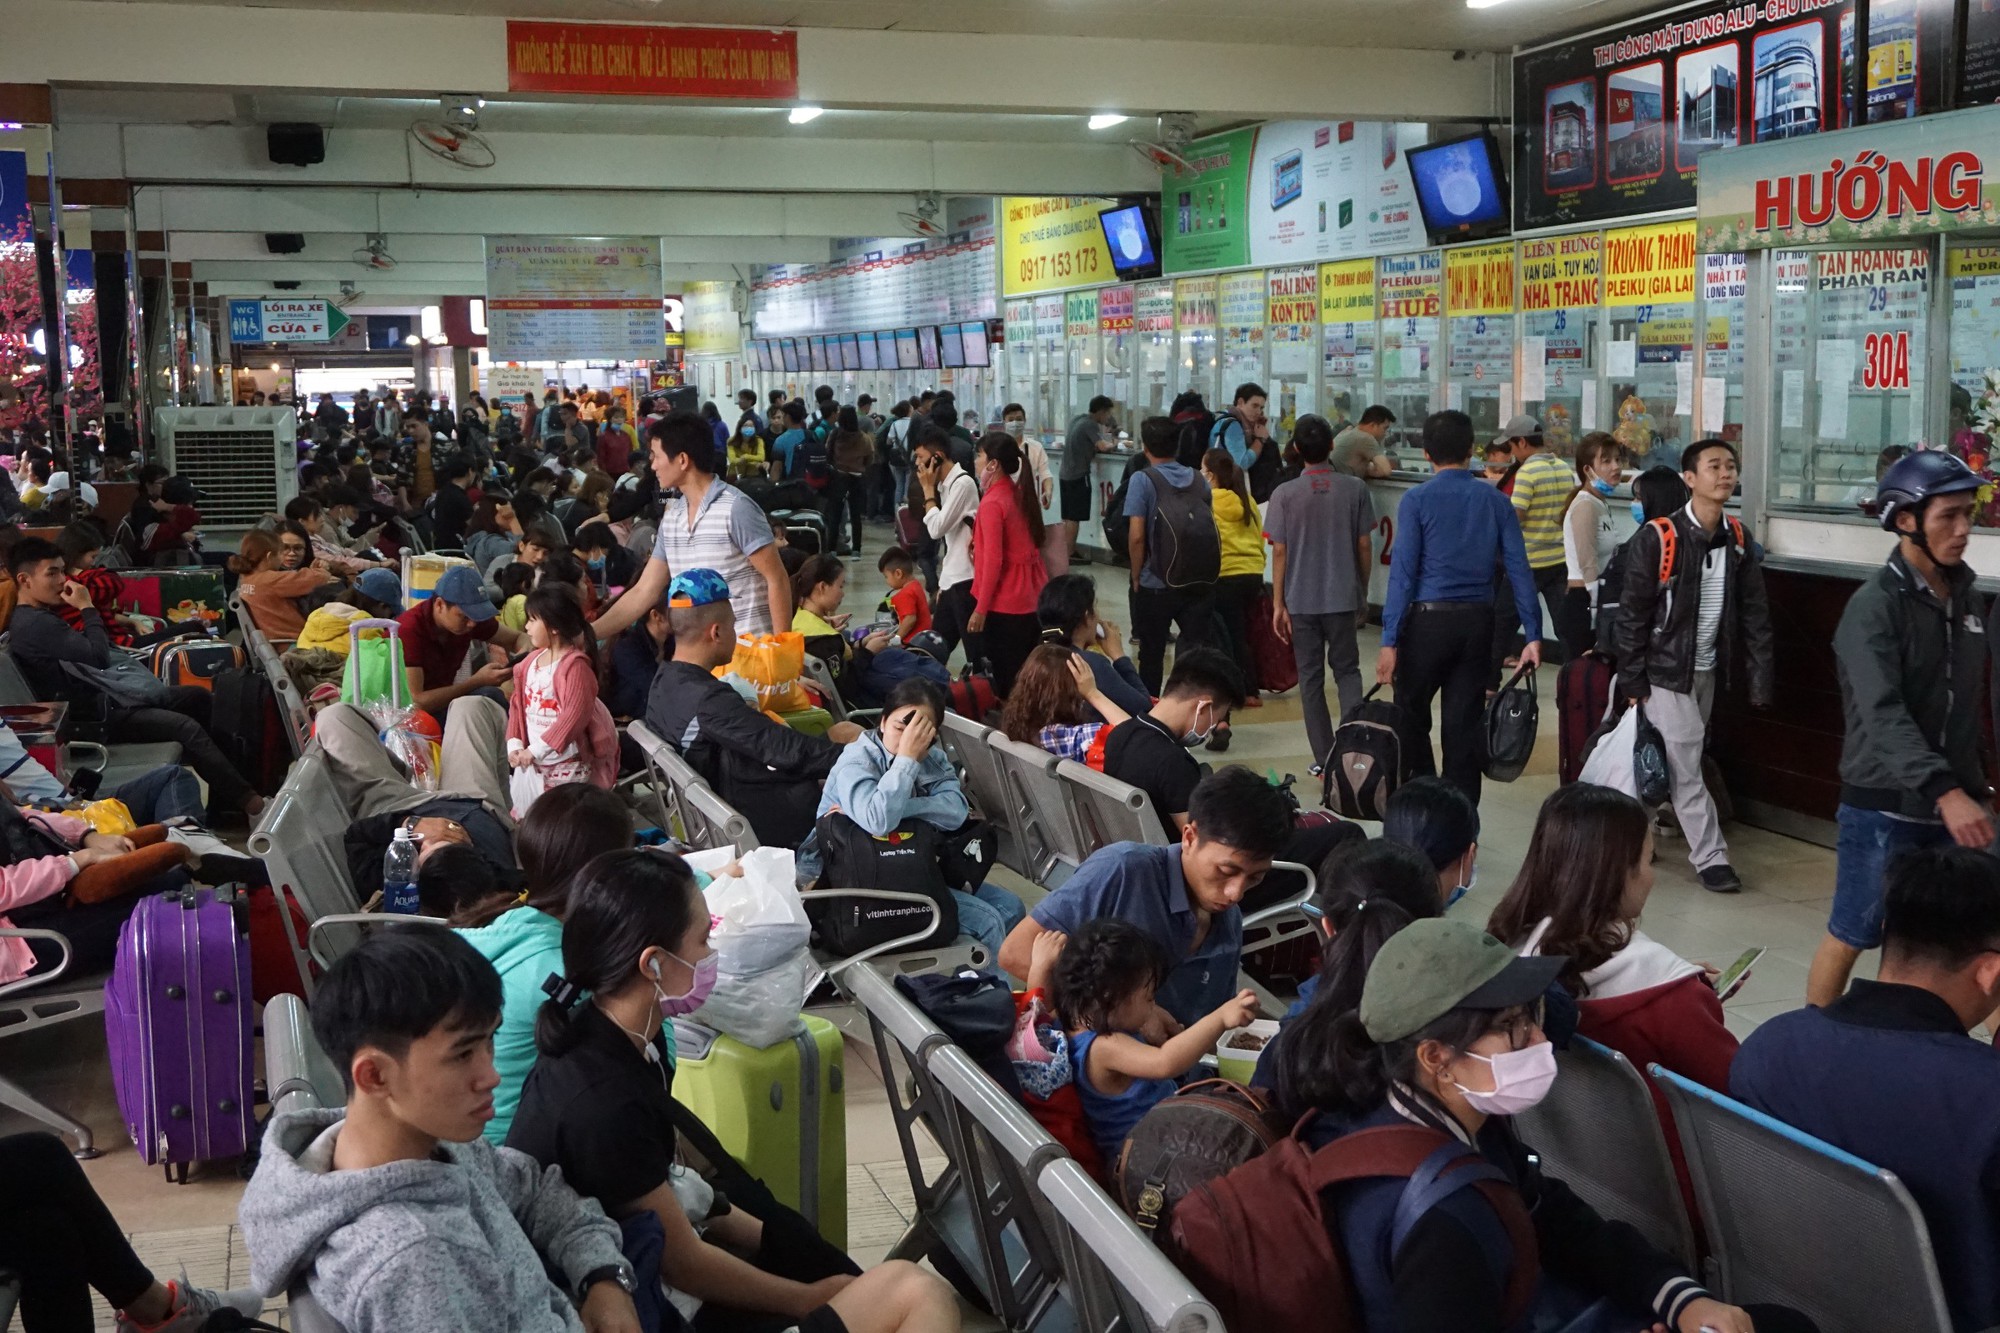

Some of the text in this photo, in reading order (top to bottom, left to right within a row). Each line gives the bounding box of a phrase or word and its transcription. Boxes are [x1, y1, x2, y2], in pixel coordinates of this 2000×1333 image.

[1594, 40, 1615, 67] THI
[1616, 36, 1651, 62] CÔNG
[1725, 4, 1756, 33] ALU
[516, 35, 550, 73] KHÔNG
[591, 43, 605, 75] RA
[701, 42, 726, 79] PHÚC
[771, 43, 790, 80] NHÀ
[1755, 150, 1982, 231] HƯỚNG
[1524, 241, 1556, 258] LIÊN
[1607, 231, 1655, 275] TRƯỜNG
[1020, 246, 1097, 282] 0917 153 173
[1382, 256, 1416, 275] Thuận
[1524, 264, 1539, 285] VẠN
[1564, 259, 1580, 277] TUY
[1271, 271, 1292, 296] THÁI
[1381, 276, 1422, 288] PLEIKU
[1607, 273, 1693, 298] PLEIKU (GIA LAI
[1819, 273, 1874, 290] PHAN
[1882, 267, 1927, 283] RAN
[1523, 281, 1550, 309] NHA
[1706, 285, 1726, 299] LONG
[1869, 286, 1887, 312] 29
[236, 306, 254, 314] WC
[264, 302, 324, 312] LỐI RA XE
[1271, 302, 1293, 323] KON
[1638, 305, 1652, 323] 27
[267, 322, 323, 333] CỬA F
[346, 323, 360, 337] E
[1476, 316, 1485, 334] 25
[1555, 309, 1566, 330] 26
[1345, 322, 1354, 339] 23
[1662, 333, 1685, 343] MINH
[1863, 332, 1910, 390] 30A
[656, 375, 676, 387] 46
